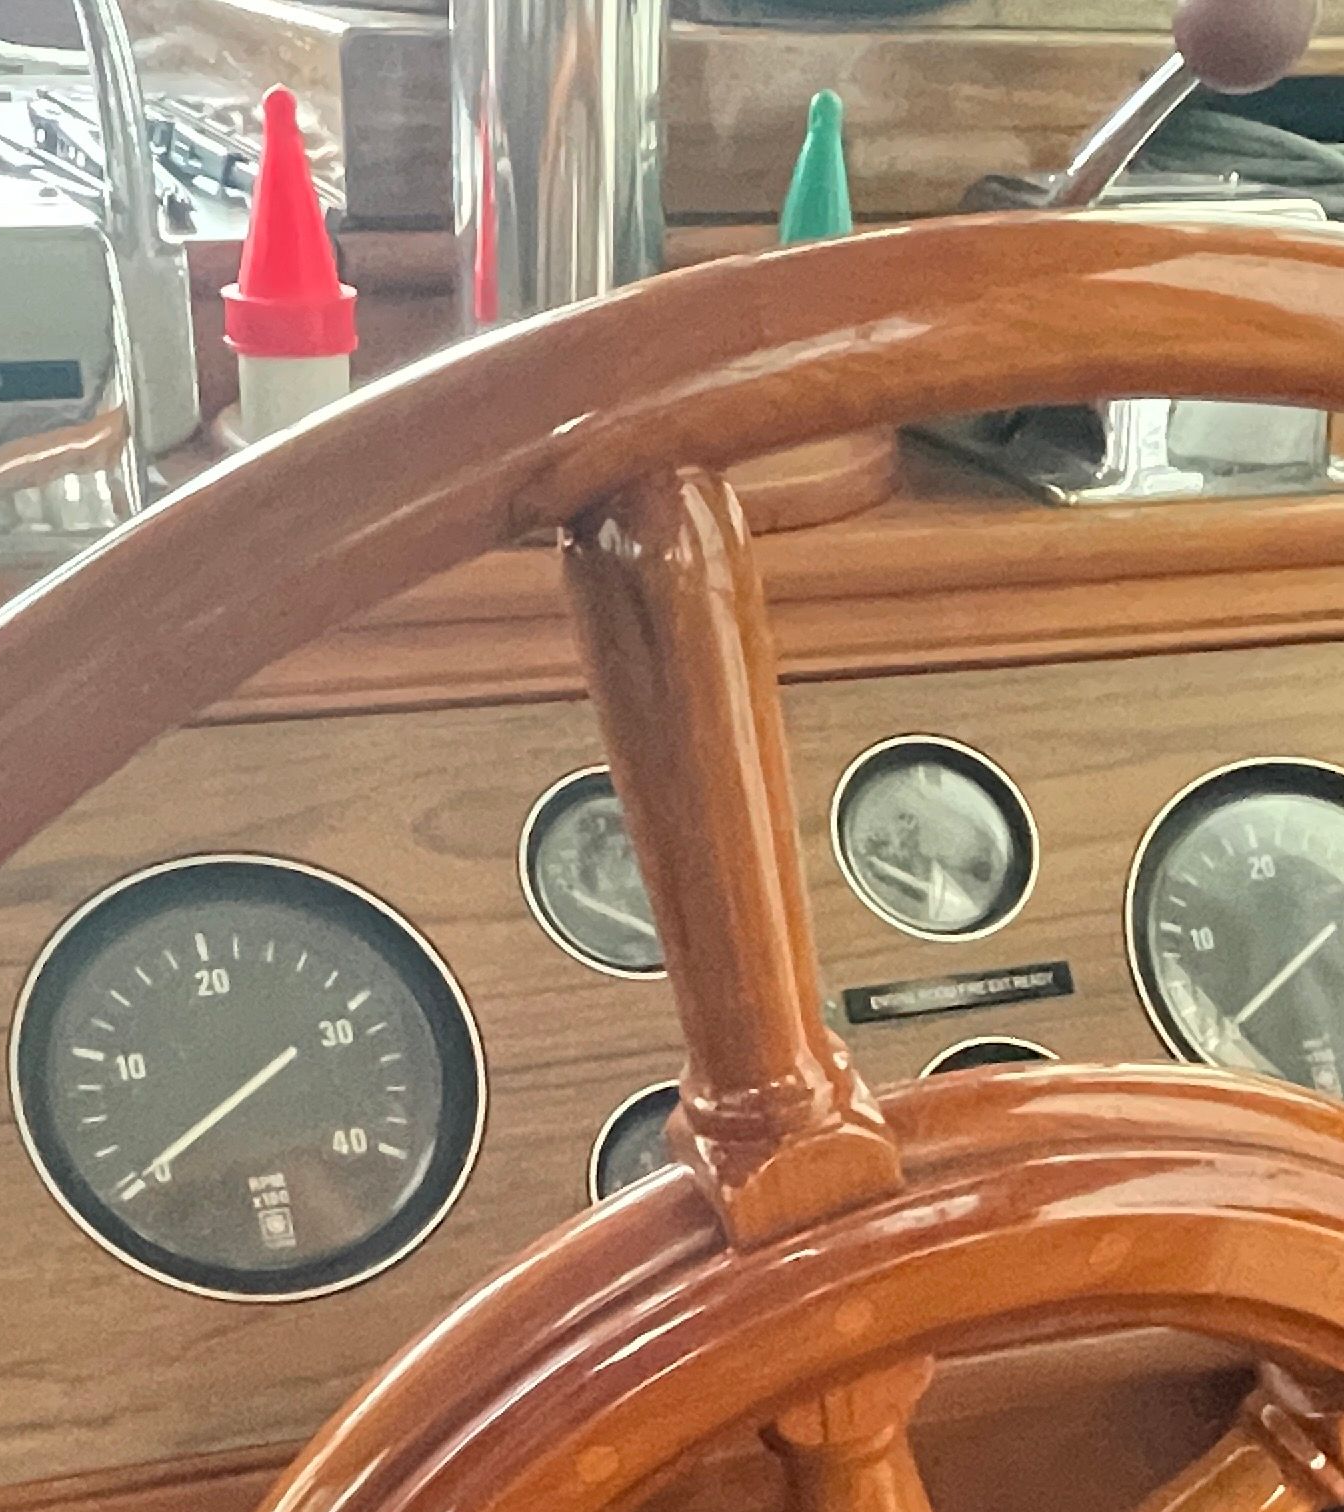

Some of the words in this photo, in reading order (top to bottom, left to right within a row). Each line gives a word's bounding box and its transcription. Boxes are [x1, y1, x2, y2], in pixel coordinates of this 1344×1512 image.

[1248, 854, 1275, 880] 20
[1190, 927, 1215, 950] 10
[195, 968, 230, 996] 20
[318, 1019, 354, 1047] 30
[116, 1053, 146, 1080] 10
[332, 1128, 368, 1154] 40
